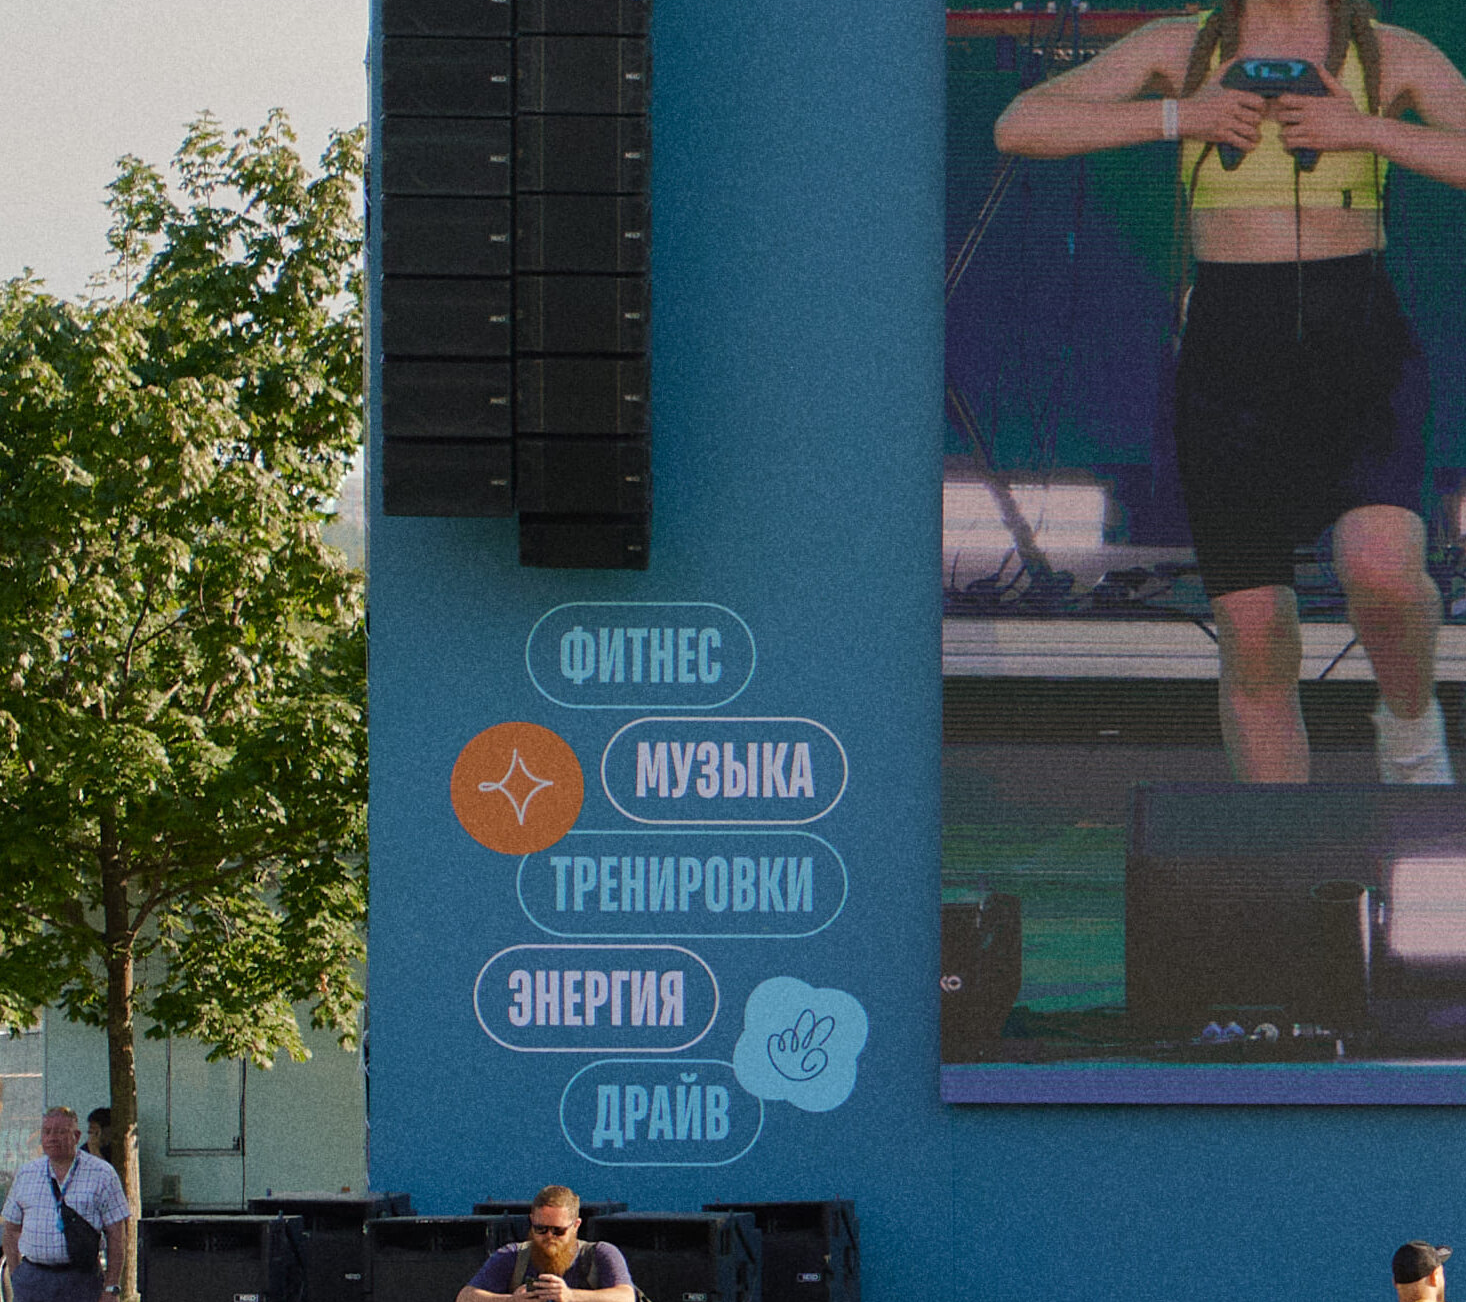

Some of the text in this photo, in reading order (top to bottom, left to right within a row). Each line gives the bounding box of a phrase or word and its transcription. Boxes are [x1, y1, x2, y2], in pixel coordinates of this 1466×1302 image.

[559, 625, 722, 685] ФИТНЕС
[635, 741, 816, 798] МУЗЫКА
[550, 855, 814, 913] ТРЕНИРОВКИ
[507, 969, 685, 1027] ЭНЕРГИЯ
[592, 1072, 731, 1149] ДРАЙВ
